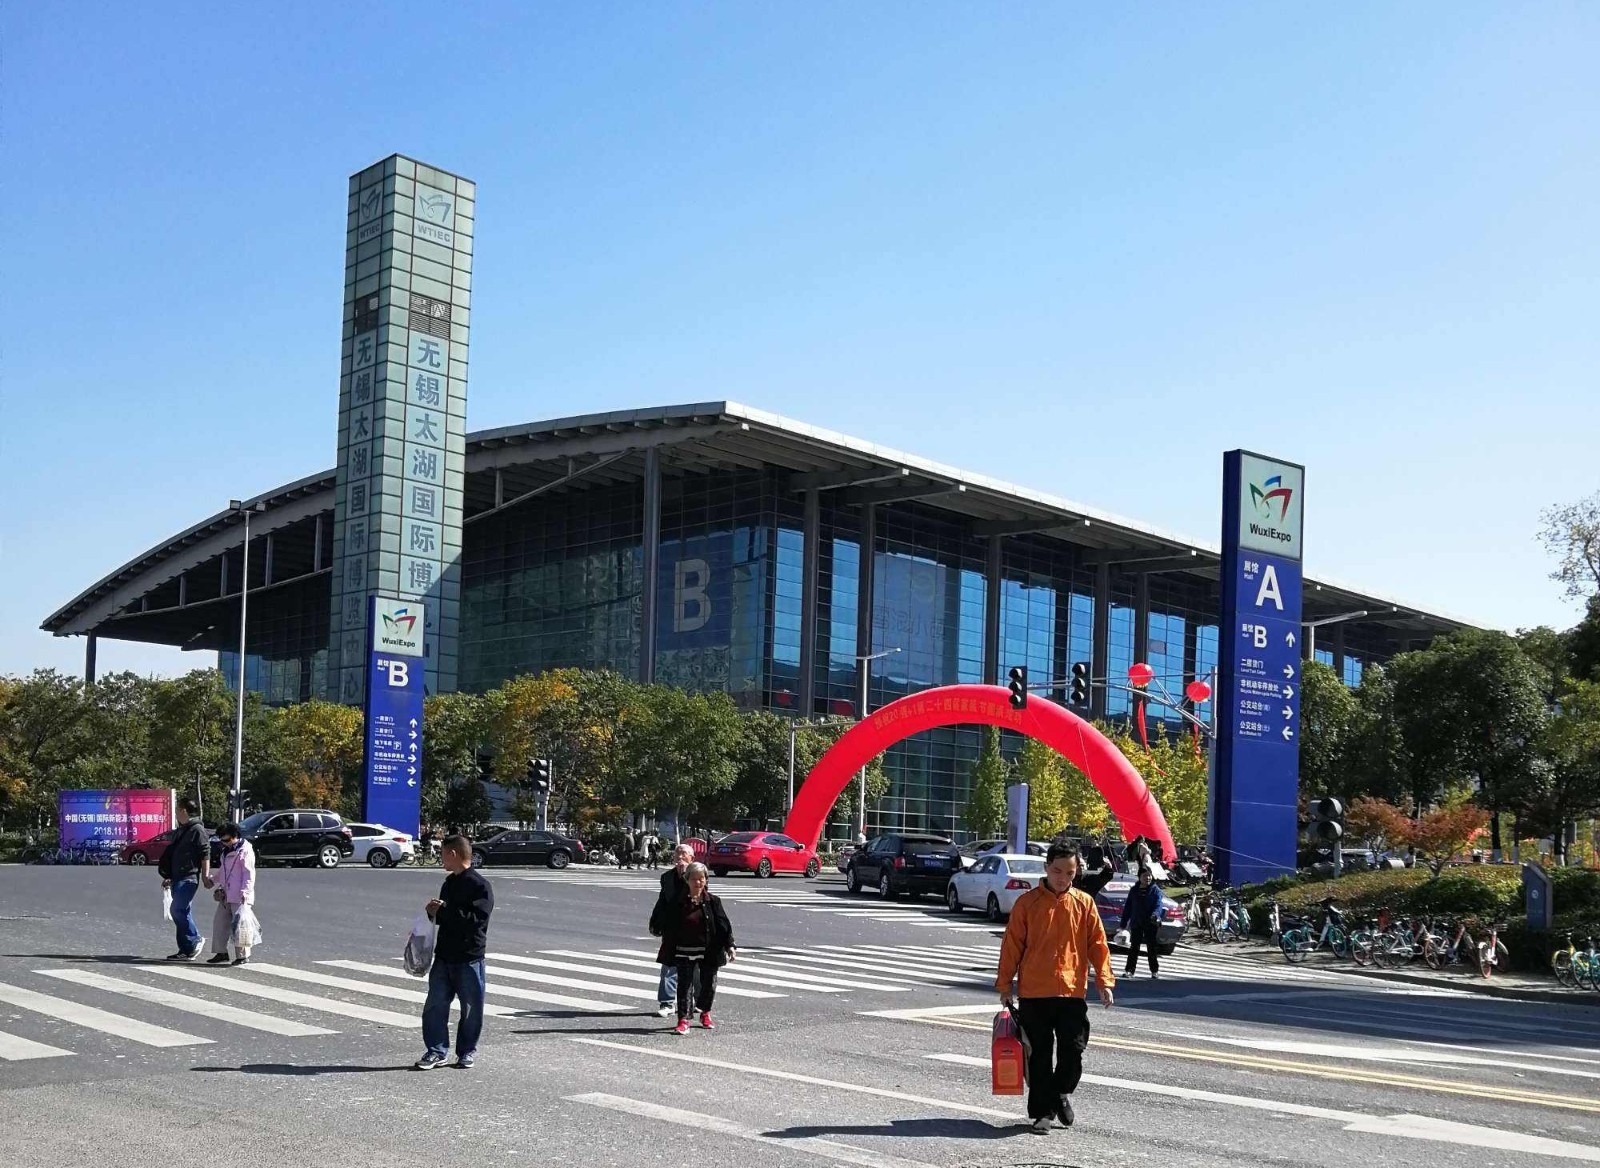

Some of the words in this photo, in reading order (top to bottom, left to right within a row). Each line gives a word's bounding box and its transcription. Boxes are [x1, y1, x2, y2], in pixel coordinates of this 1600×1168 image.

[418, 223, 451, 243] WTIEC
[1249, 523, 1292, 543] WuxiExpo
[1243, 560, 1259, 573] 展馆
[673, 558, 711, 634] B
[1255, 564, 1284, 610] A
[1242, 623, 1254, 633] 展馆
[1254, 625, 1267, 648] B
[382, 637, 416, 648] WuxiExpo
[389, 660, 409, 687] B
